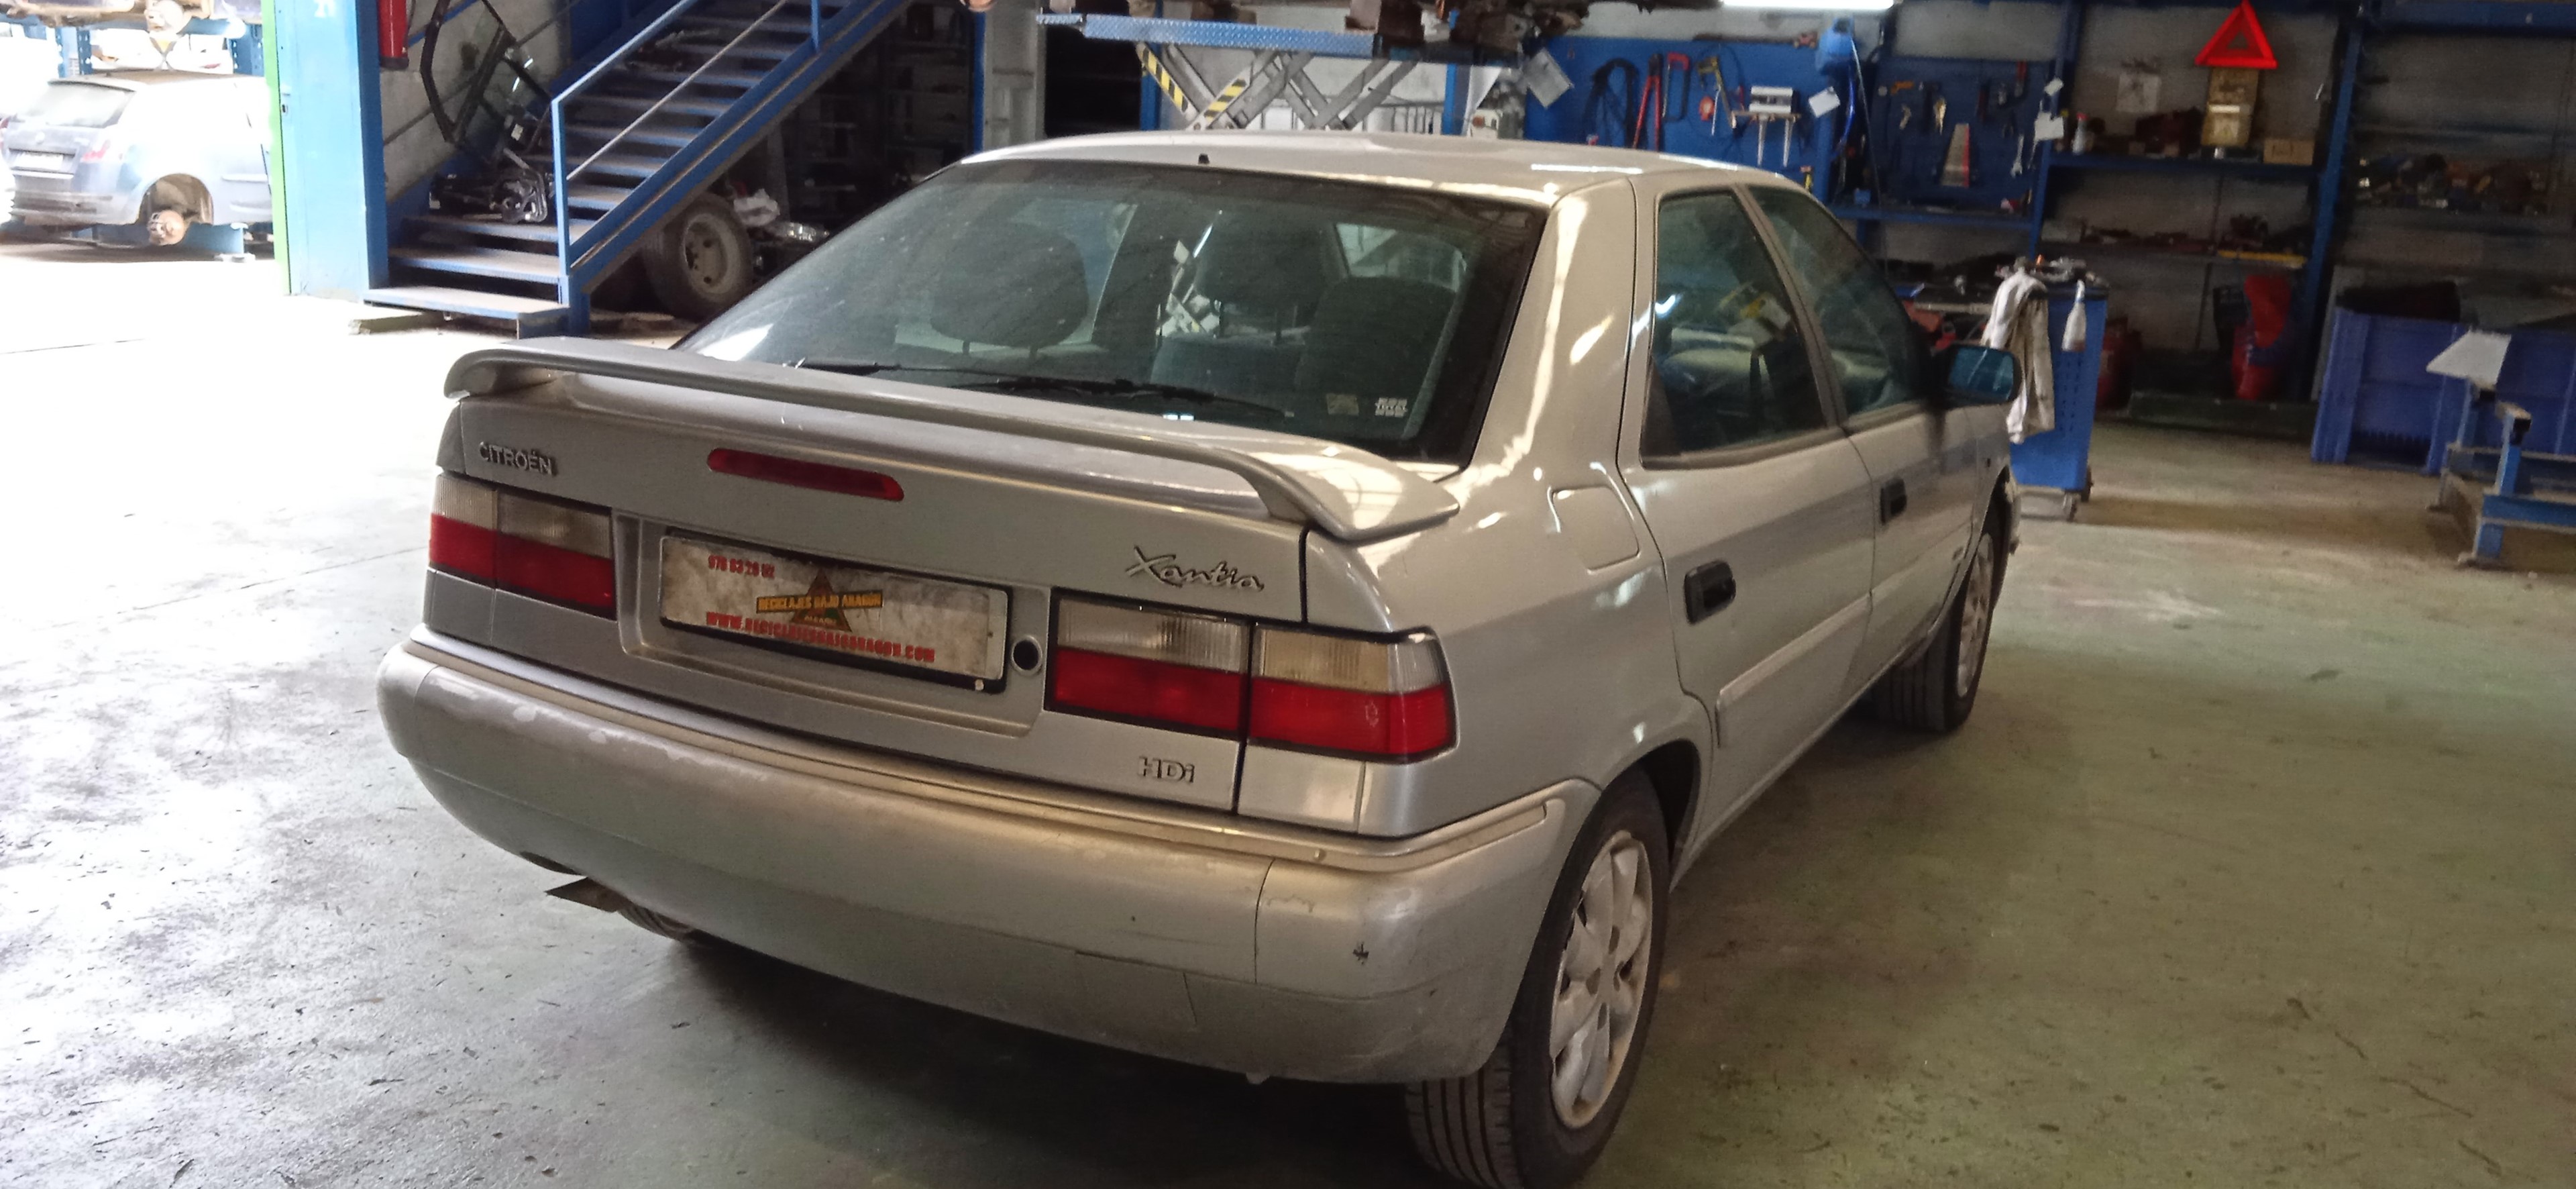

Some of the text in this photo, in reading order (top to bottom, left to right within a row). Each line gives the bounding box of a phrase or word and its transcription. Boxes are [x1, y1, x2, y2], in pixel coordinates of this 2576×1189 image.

[479, 441, 555, 476] CITROËN
[1125, 544, 1265, 592] Xantia
[1138, 756, 1195, 784] HDi
